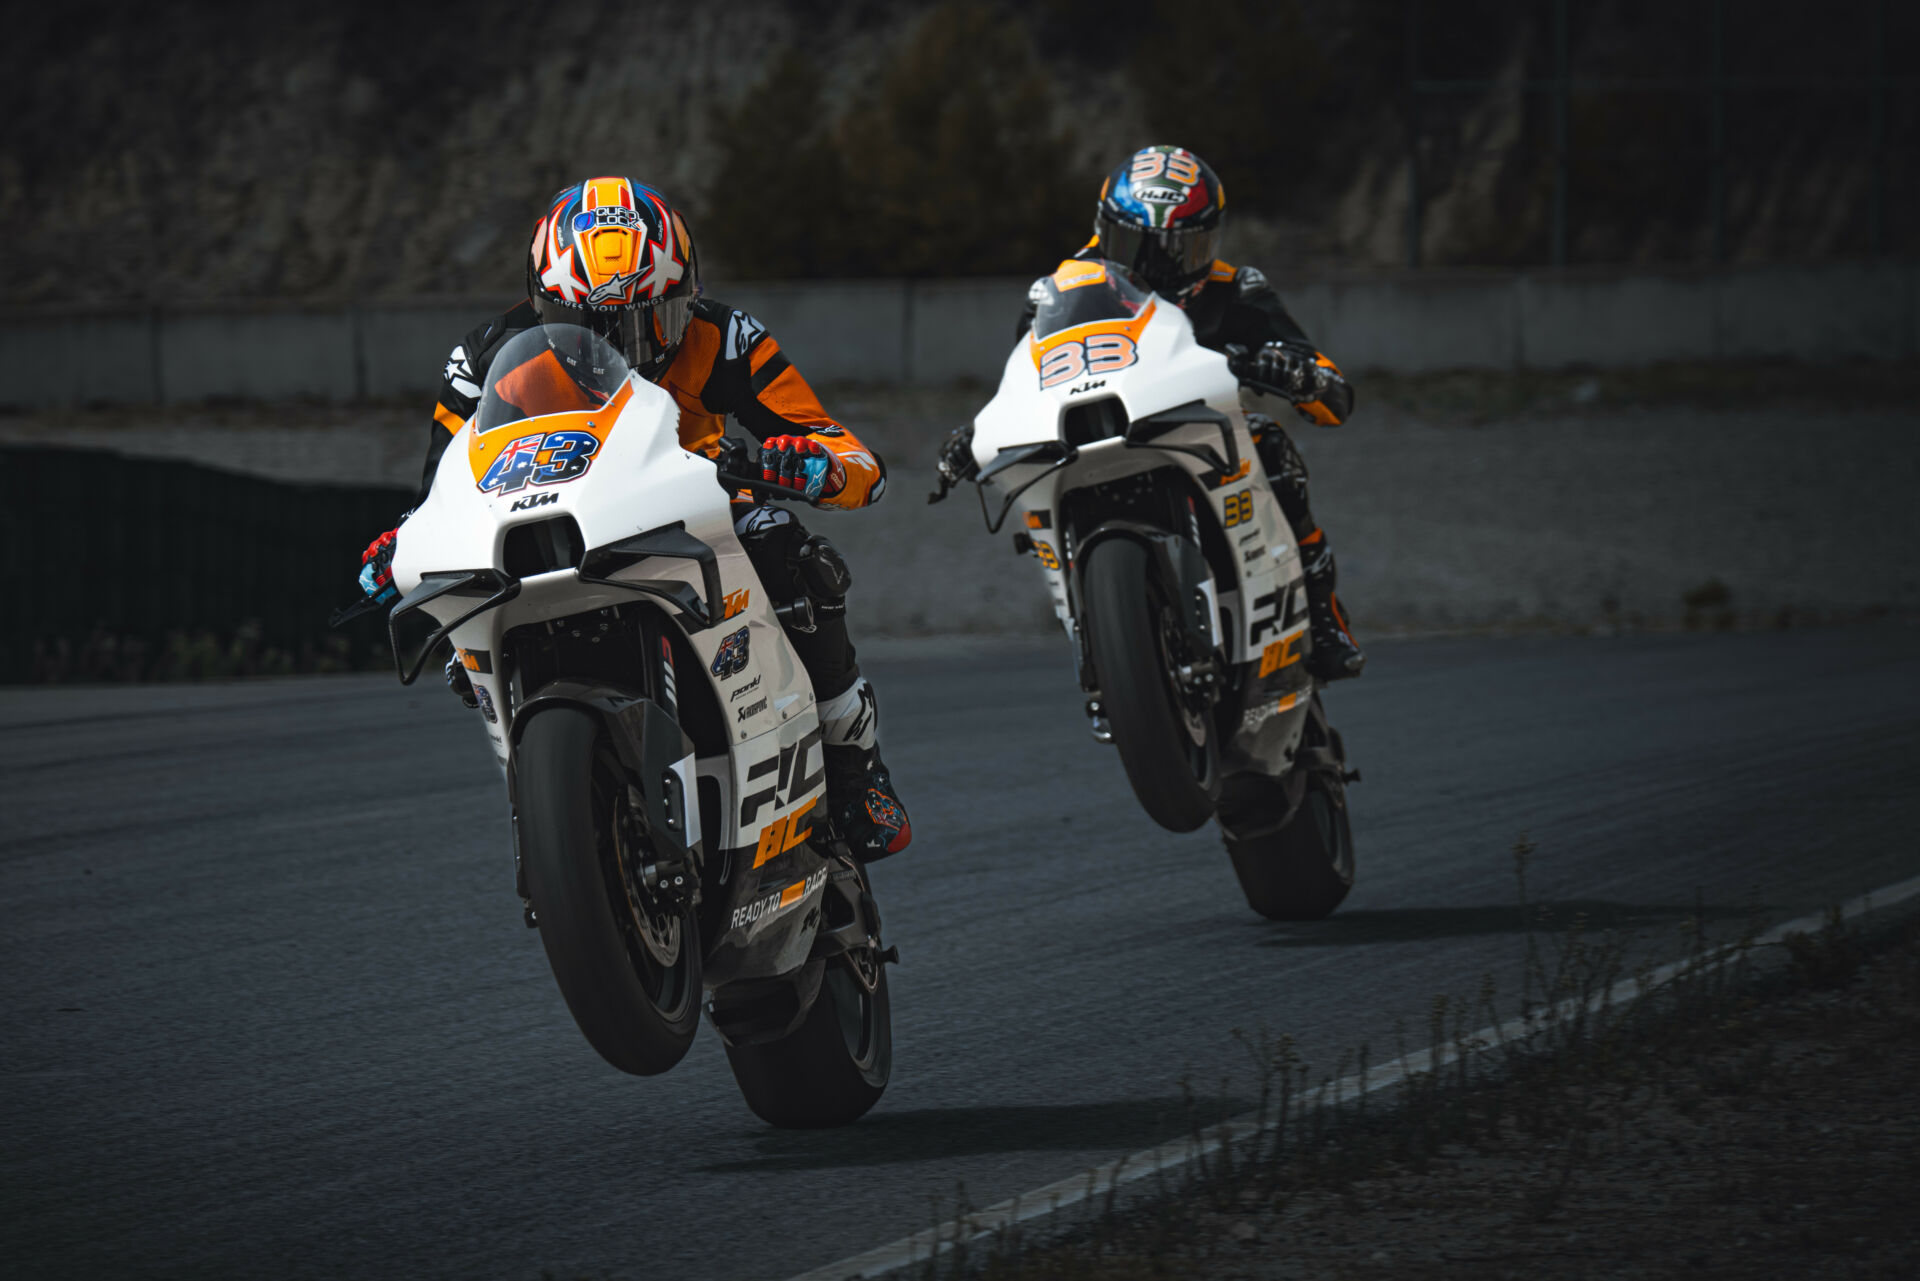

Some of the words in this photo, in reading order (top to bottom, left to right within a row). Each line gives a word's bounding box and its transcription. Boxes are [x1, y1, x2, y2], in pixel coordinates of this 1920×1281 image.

[1130, 152, 1200, 186] 33
[1141, 190, 1184, 202] HJC
[596, 207, 638, 220] QUAD
[596, 216, 640, 230] LOCK
[553, 298, 584, 311] GIVES
[591, 304, 618, 312] YOU
[624, 296, 665, 311] WINGS
[1039, 333, 1139, 392] 33
[476, 430, 603, 497] 43
[510, 491, 560, 513] KTM
[1223, 488, 1255, 530] 33
[723, 588, 751, 620] TM
[710, 625, 750, 682] 43
[752, 795, 818, 870] 8C
[731, 893, 767, 929] READY
[767, 892, 781, 914] TO
[803, 866, 828, 897] RACE
